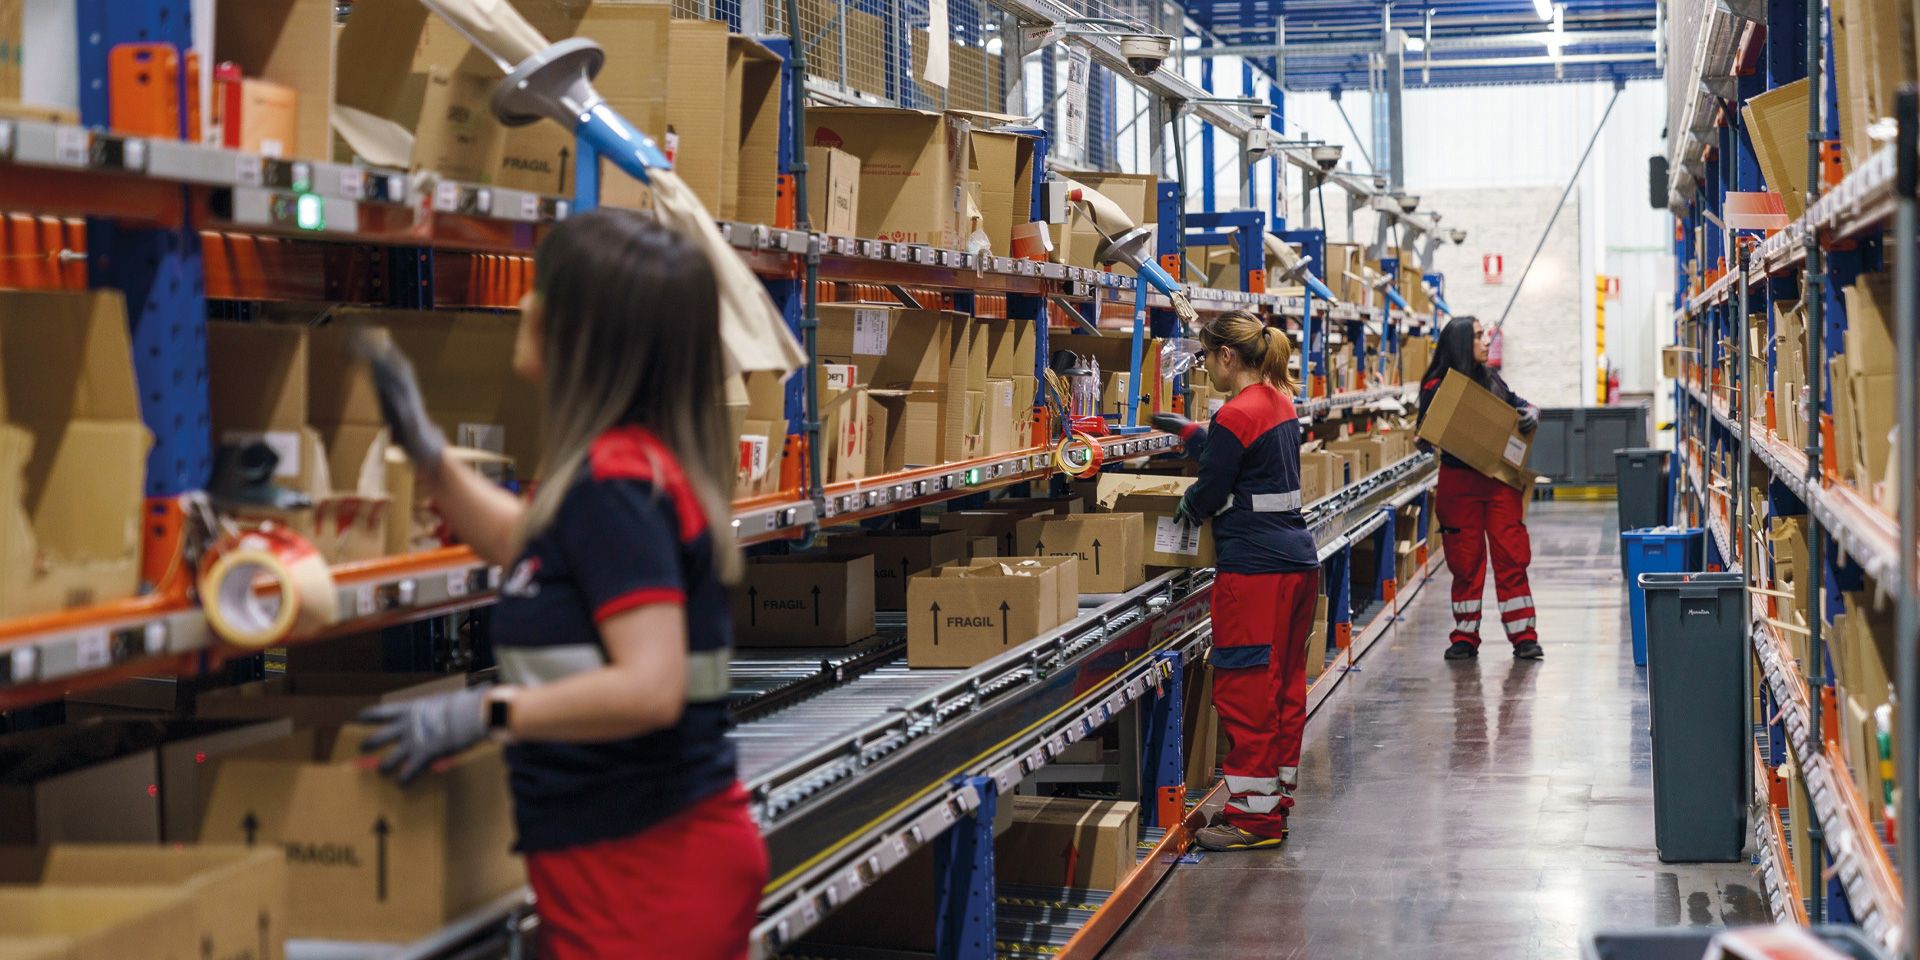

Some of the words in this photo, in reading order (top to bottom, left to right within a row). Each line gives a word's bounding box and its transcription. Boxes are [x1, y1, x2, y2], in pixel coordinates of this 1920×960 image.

[503, 156, 551, 174] FRAGIL
[763, 600, 807, 610] FRAGIL
[946, 616, 995, 628] FRAGIL
